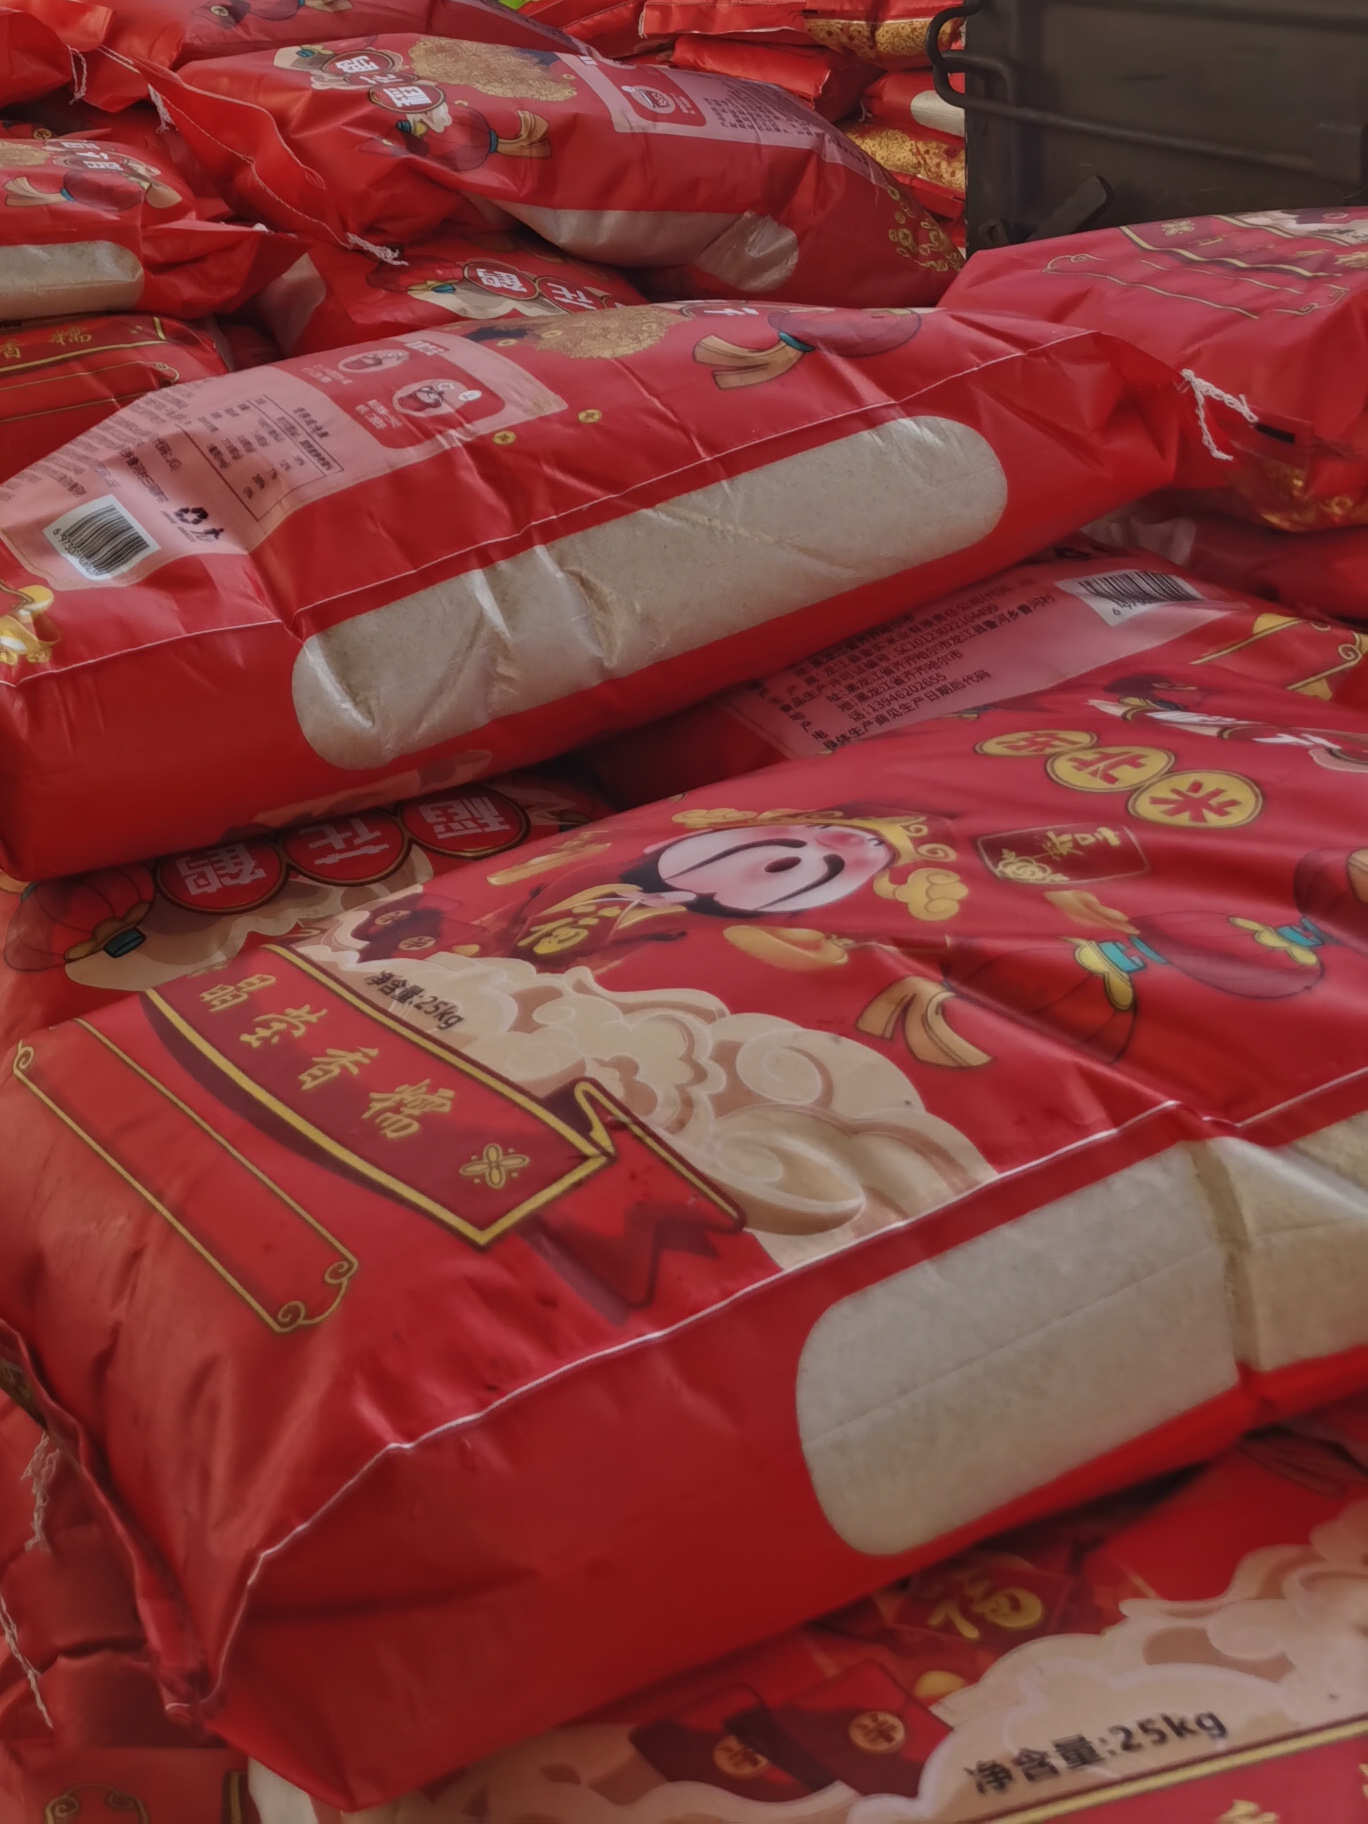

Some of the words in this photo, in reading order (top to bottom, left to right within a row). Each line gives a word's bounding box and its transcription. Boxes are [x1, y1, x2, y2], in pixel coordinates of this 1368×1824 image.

[364, 970, 464, 1030] 净含量:25kg
[199, 973, 456, 1139] 晶莹香糯
[966, 1710, 1228, 1795] 净含量:25kg
